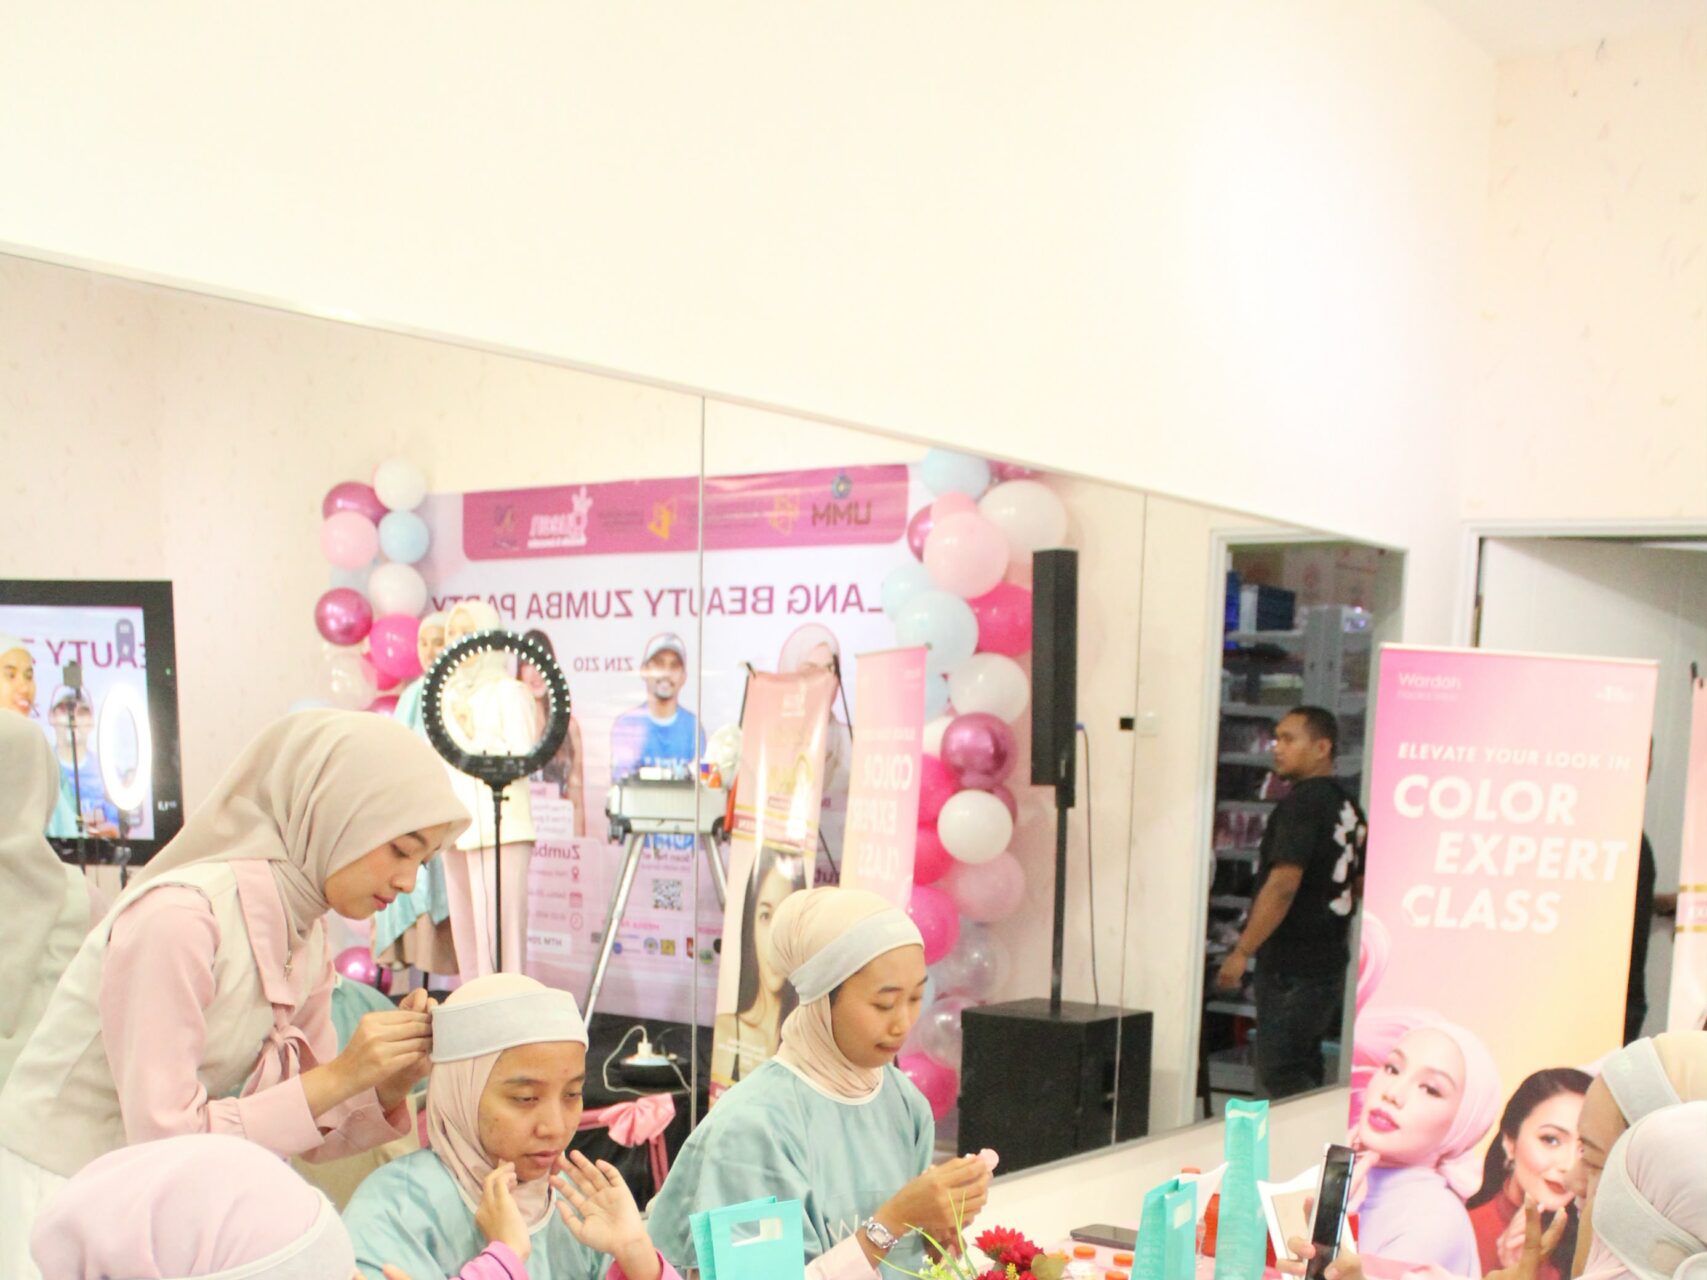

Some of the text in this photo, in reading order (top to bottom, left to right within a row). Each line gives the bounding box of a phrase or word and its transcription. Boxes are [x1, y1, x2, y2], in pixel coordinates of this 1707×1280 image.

[1397, 741, 1634, 772] ELEVATE YOUR LOOK IN
[1393, 774, 1579, 826] COLOR
[1433, 831, 1629, 882] EXPERT
[1402, 884, 1562, 935] CLASS
